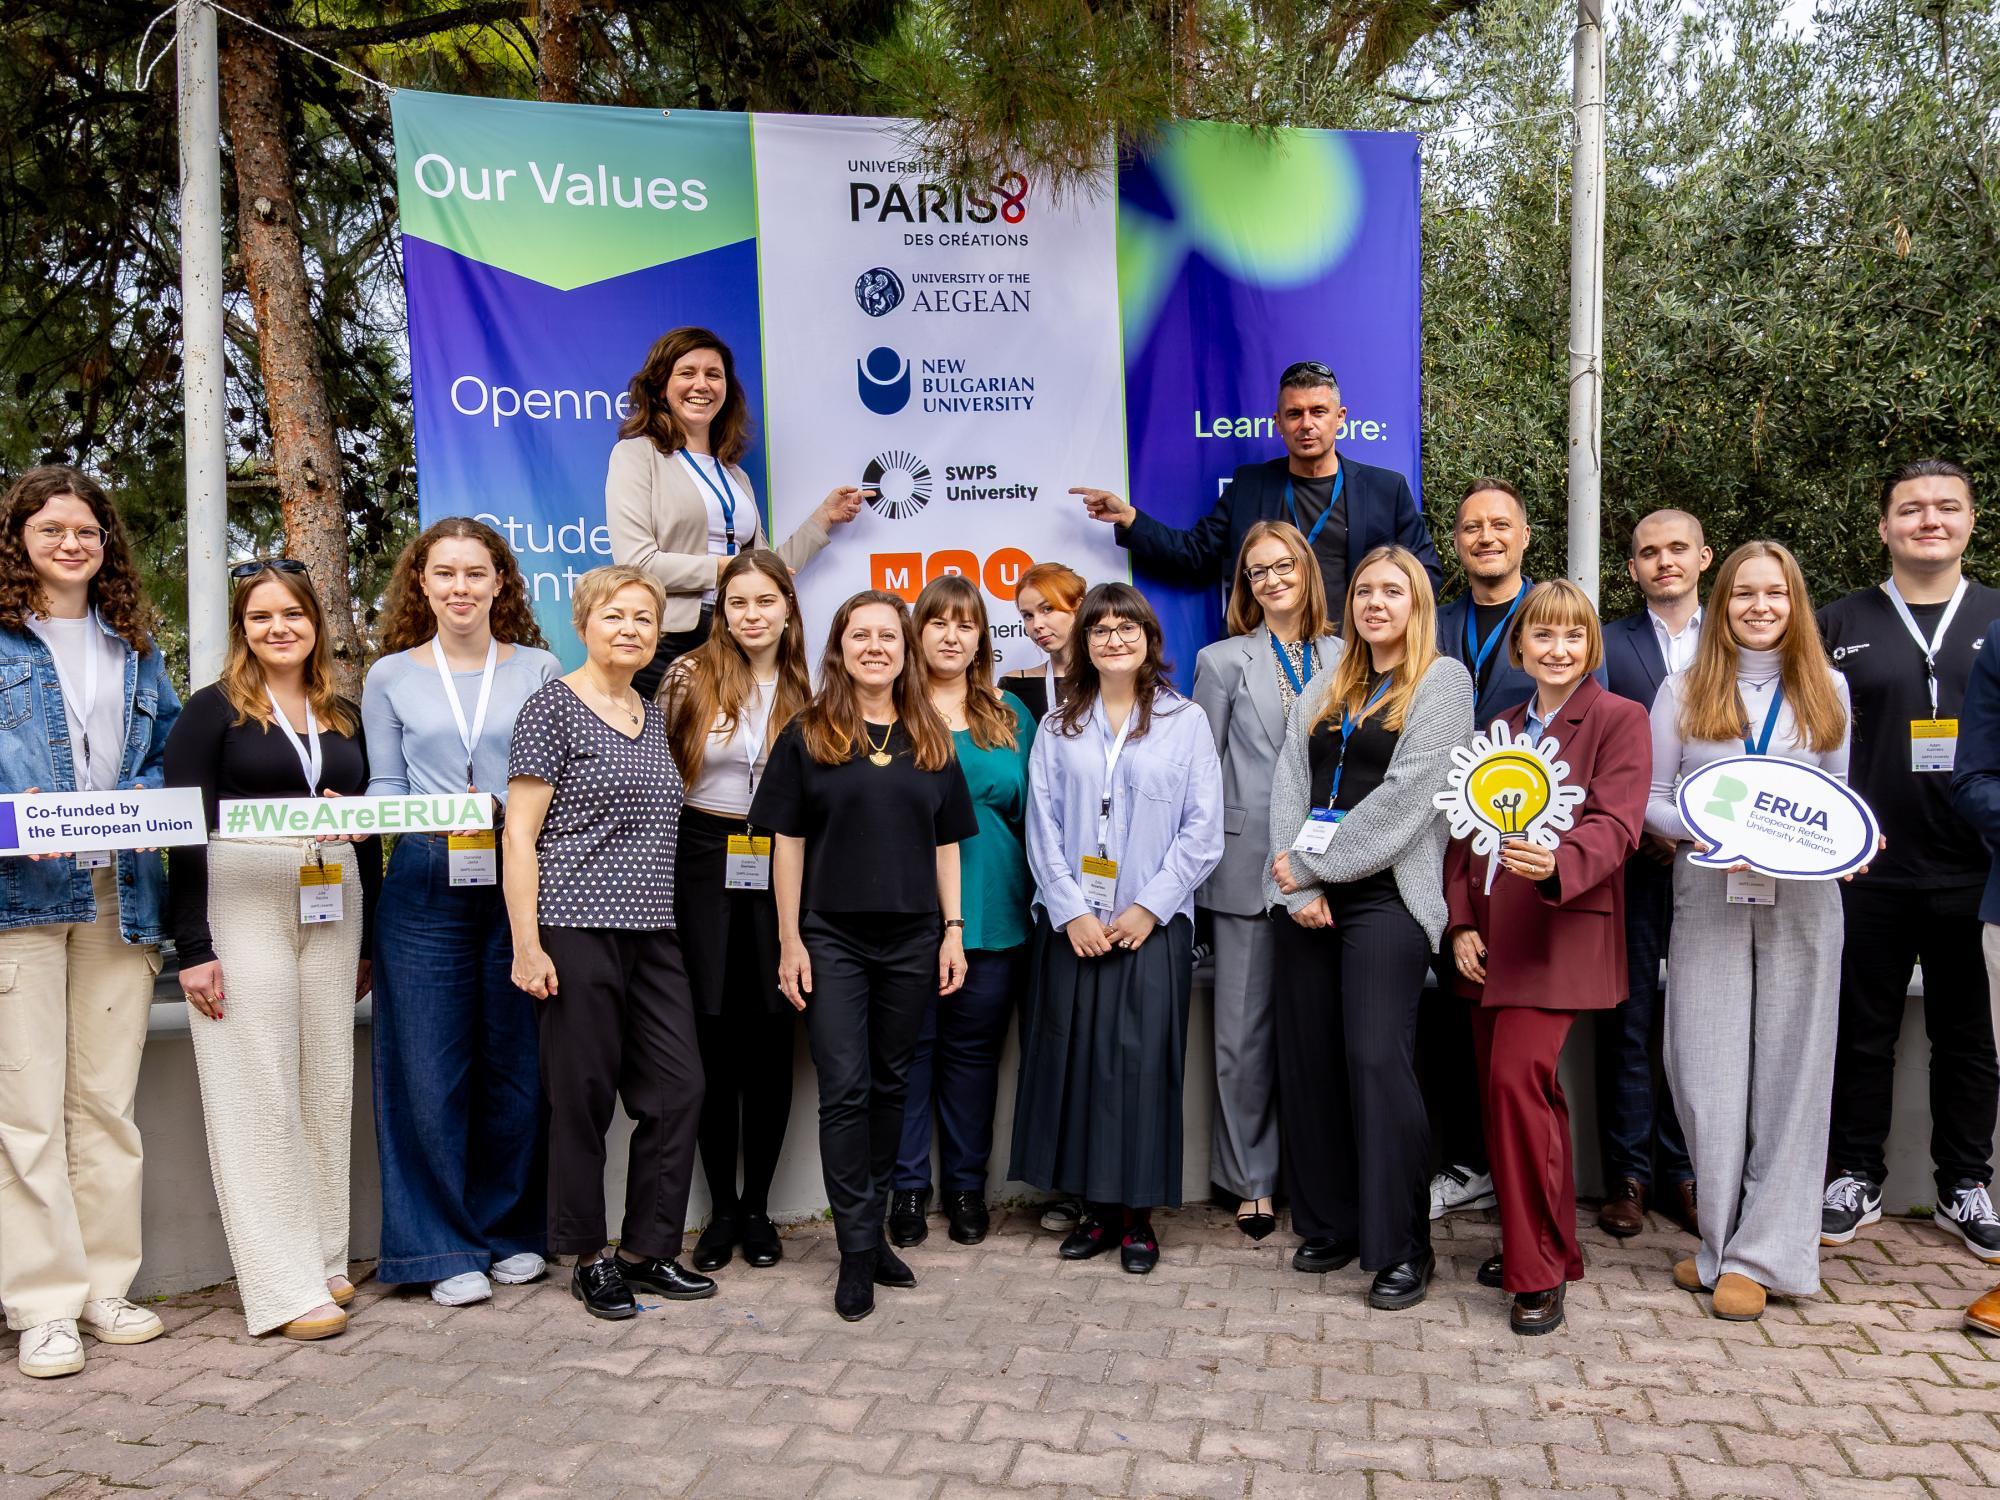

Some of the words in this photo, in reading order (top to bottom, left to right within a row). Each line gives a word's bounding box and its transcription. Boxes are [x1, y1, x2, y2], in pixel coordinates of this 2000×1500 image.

[414, 153, 516, 200] Our
[528, 162, 708, 211] Values
[904, 233, 933, 246] DES
[939, 231, 1028, 246] CRÉATIONS
[912, 273, 985, 283] UNIVERSITY
[989, 273, 1004, 283] OF
[1008, 273, 1030, 283] THE
[912, 289, 1031, 312] AEGEAN
[922, 359, 965, 373] NEW
[922, 376, 1034, 393] BULGARIAN
[451, 375, 639, 428] Openne
[923, 396, 1034, 413] UNIVERSITY
[1335, 419, 1387, 441] ore:
[945, 464, 997, 481] SWPS
[946, 483, 1038, 502] University
[26, 803, 115, 819] Co-funded
[120, 802, 140, 817] by
[227, 798, 485, 833] #WeAreERUA
[1754, 791, 1828, 831] ERUA
[28, 825, 55, 839] the
[61, 822, 141, 837] European
[146, 819, 193, 832] Union
[1750, 810, 1795, 832] European
[1798, 826, 1834, 844] Reform
[1746, 819, 1794, 843] University
[1796, 837, 1837, 856] Alliance
